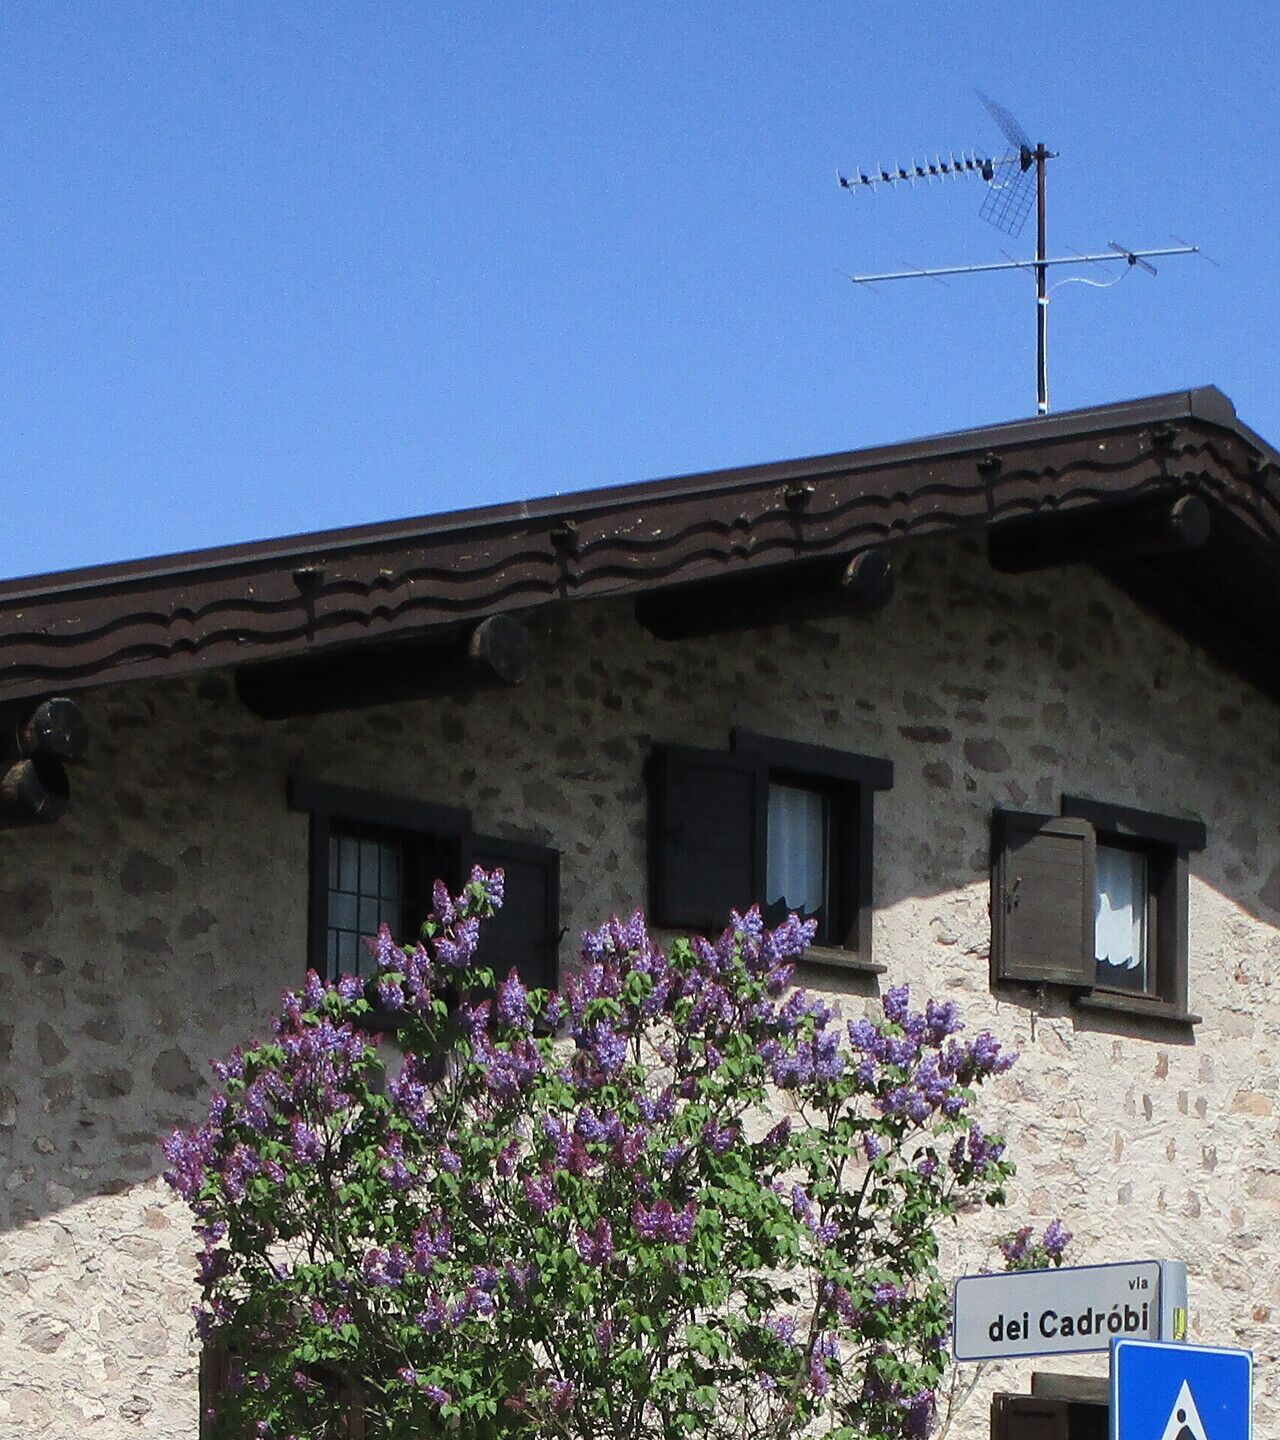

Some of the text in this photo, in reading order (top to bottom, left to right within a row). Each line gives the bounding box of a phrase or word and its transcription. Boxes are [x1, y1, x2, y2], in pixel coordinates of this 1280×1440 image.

[1128, 1276, 1149, 1291] via
[988, 1302, 1149, 1342] dei Cadróbi
